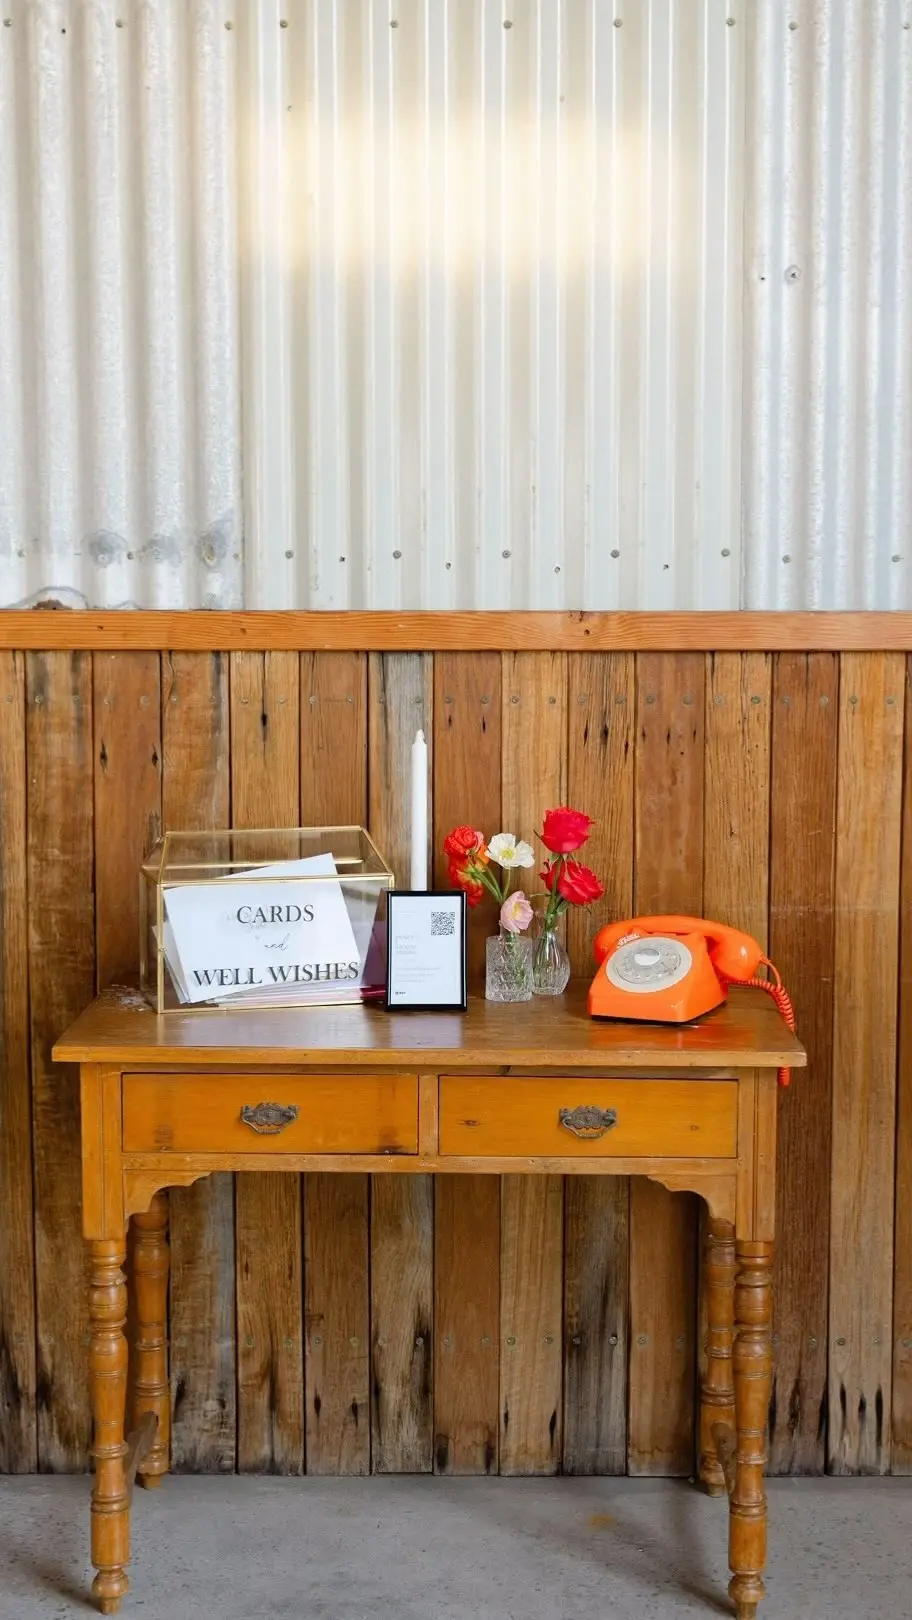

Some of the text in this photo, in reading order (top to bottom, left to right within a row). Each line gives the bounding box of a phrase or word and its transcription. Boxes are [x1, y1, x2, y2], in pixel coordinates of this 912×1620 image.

[236, 904, 314, 924] CARDS
[263, 933, 290, 951] and
[193, 961, 360, 987] WELL WISHES
